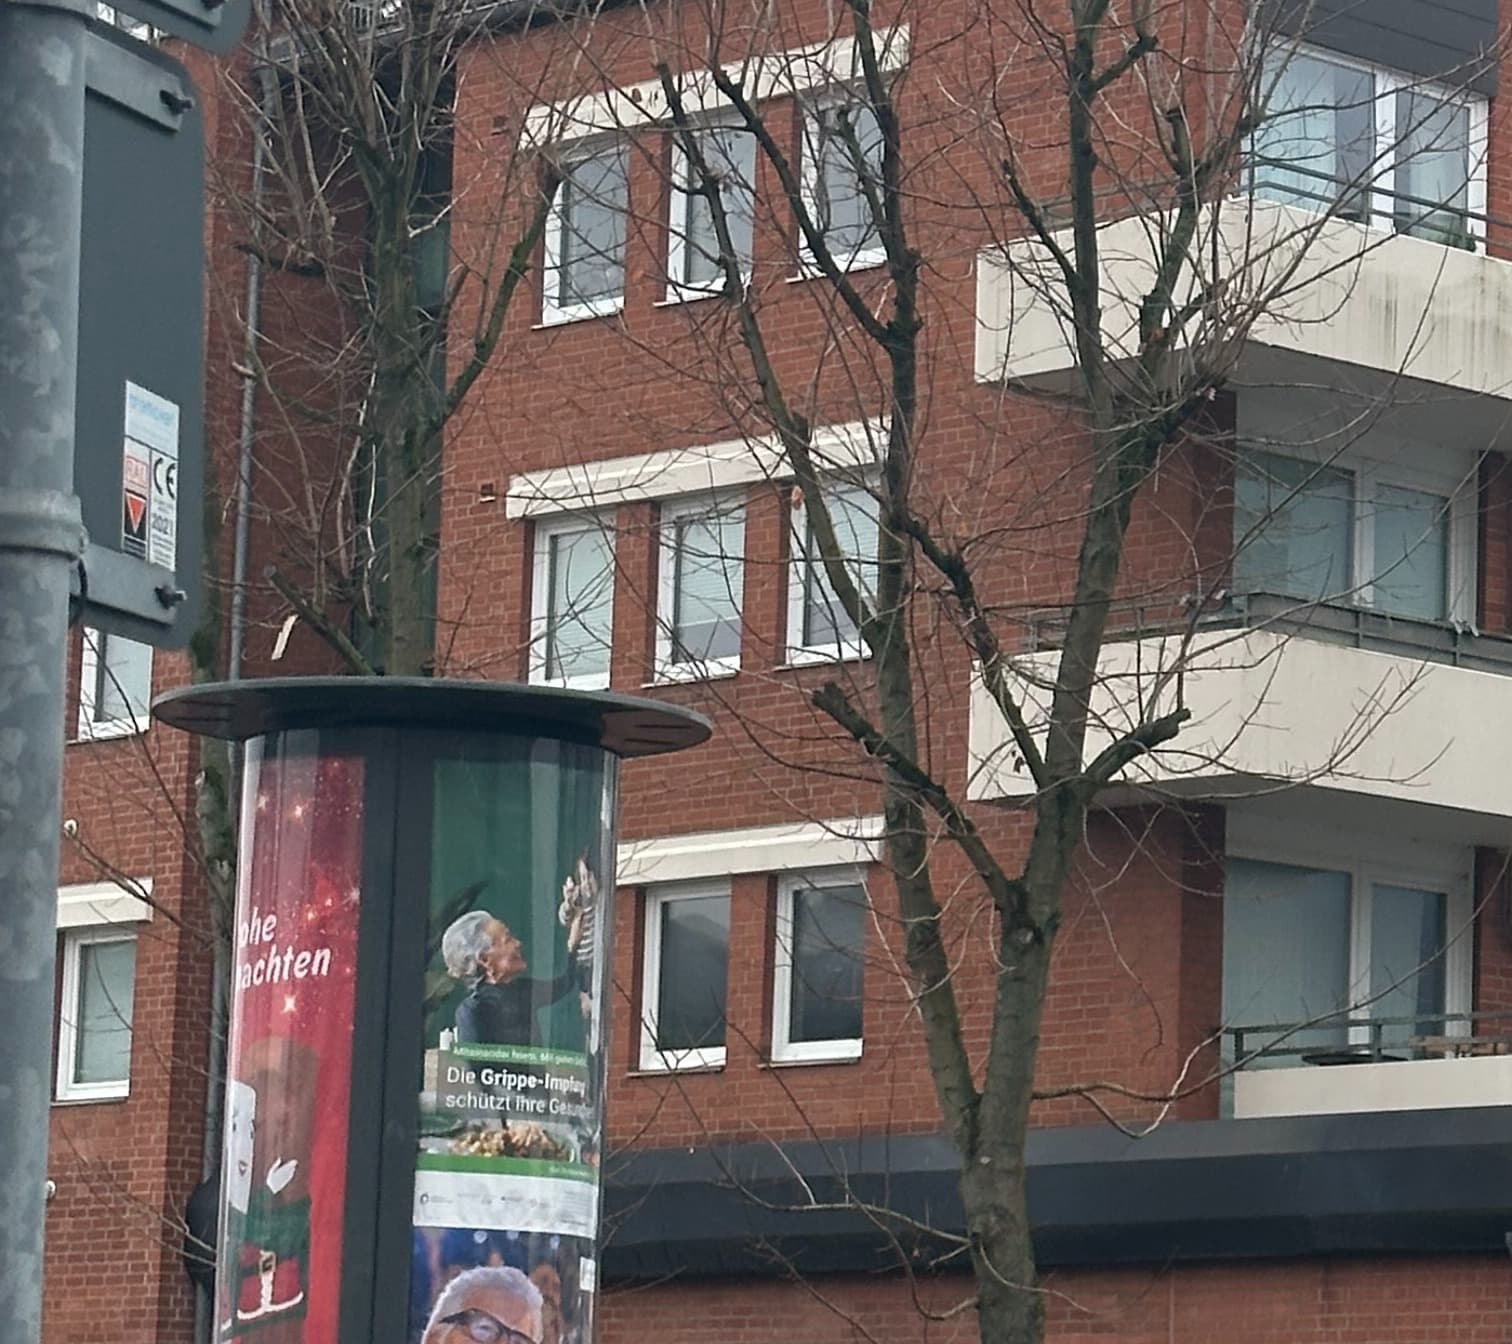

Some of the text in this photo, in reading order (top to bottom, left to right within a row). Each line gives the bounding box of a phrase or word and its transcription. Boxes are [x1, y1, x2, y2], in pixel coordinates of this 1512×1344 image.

[239, 906, 277, 948] ohe
[447, 1066, 476, 1085] Die
[445, 1090, 511, 1112] schützt
[515, 1094, 545, 1113] Ihre
